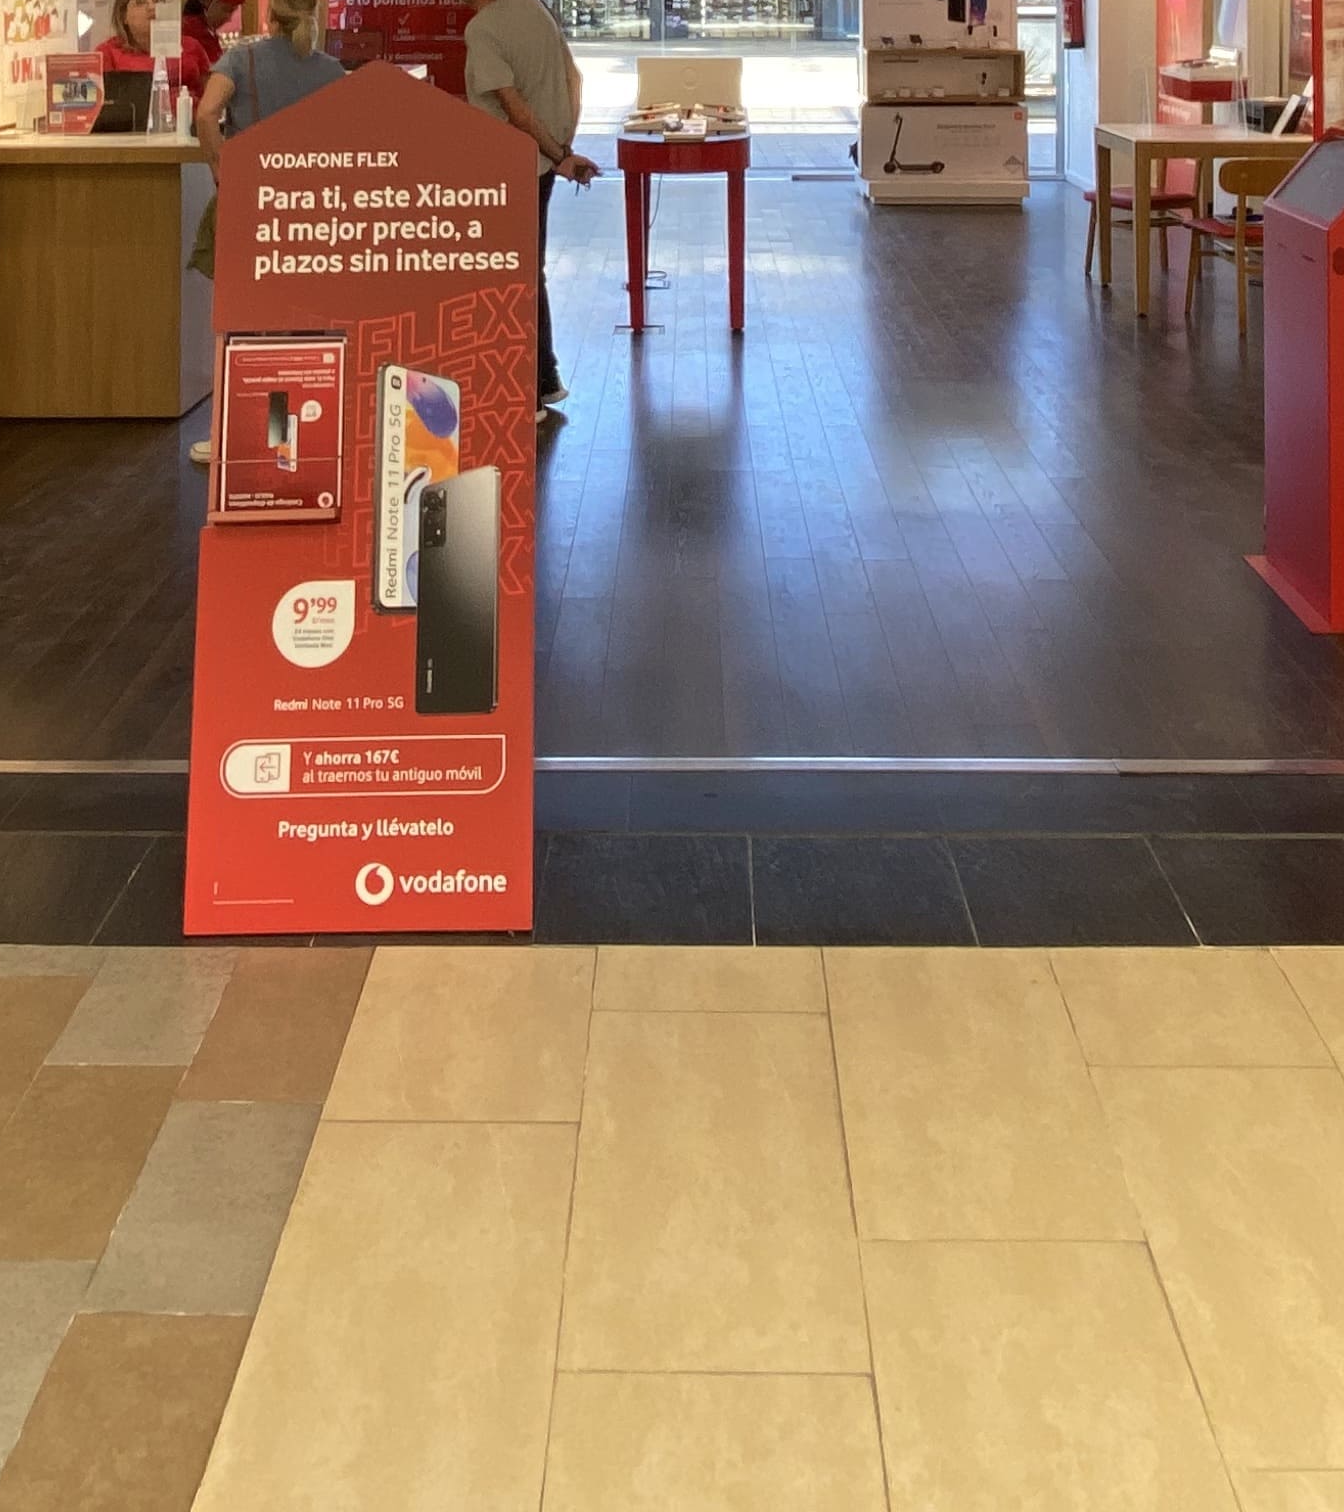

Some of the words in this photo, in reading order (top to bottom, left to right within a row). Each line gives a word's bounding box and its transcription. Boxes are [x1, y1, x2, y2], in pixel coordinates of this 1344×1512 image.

[259, 153, 353, 169] VODAFONE
[357, 152, 398, 168] FLEX
[257, 185, 315, 210] Para
[322, 185, 347, 212] ti,
[353, 186, 410, 208] este
[416, 183, 507, 207] Xiaomi
[255, 218, 281, 242] al
[288, 217, 367, 246] mejor
[373, 216, 461, 246] precio,
[467, 220, 483, 238] a
[254, 250, 343, 280] plazos
[350, 249, 388, 272] sin
[396, 248, 520, 272] intereses
[358, 284, 527, 376] FLEX
[389, 404, 402, 427] 5G
[388, 435, 401, 459] Pro
[388, 471, 400, 488] 11
[387, 496, 399, 540] Note
[385, 548, 398, 599] Redmi
[273, 699, 307, 711] Redmi
[312, 698, 341, 710] Note
[347, 698, 359, 709] 11
[363, 698, 383, 709] Pro
[387, 697, 404, 709] 5G
[303, 752, 312, 765] Y
[315, 752, 361, 766] ahorra
[365, 750, 399, 764] 167€
[302, 769, 314, 784] al
[318, 769, 372, 783] traernos
[376, 769, 389, 782] tu
[392, 767, 442, 785] antiguo
[446, 766, 483, 781] móvil
[278, 820, 358, 842] Pregunta
[361, 822, 373, 840] y
[376, 818, 454, 837] llévatelo
[399, 869, 507, 893] vodafone
